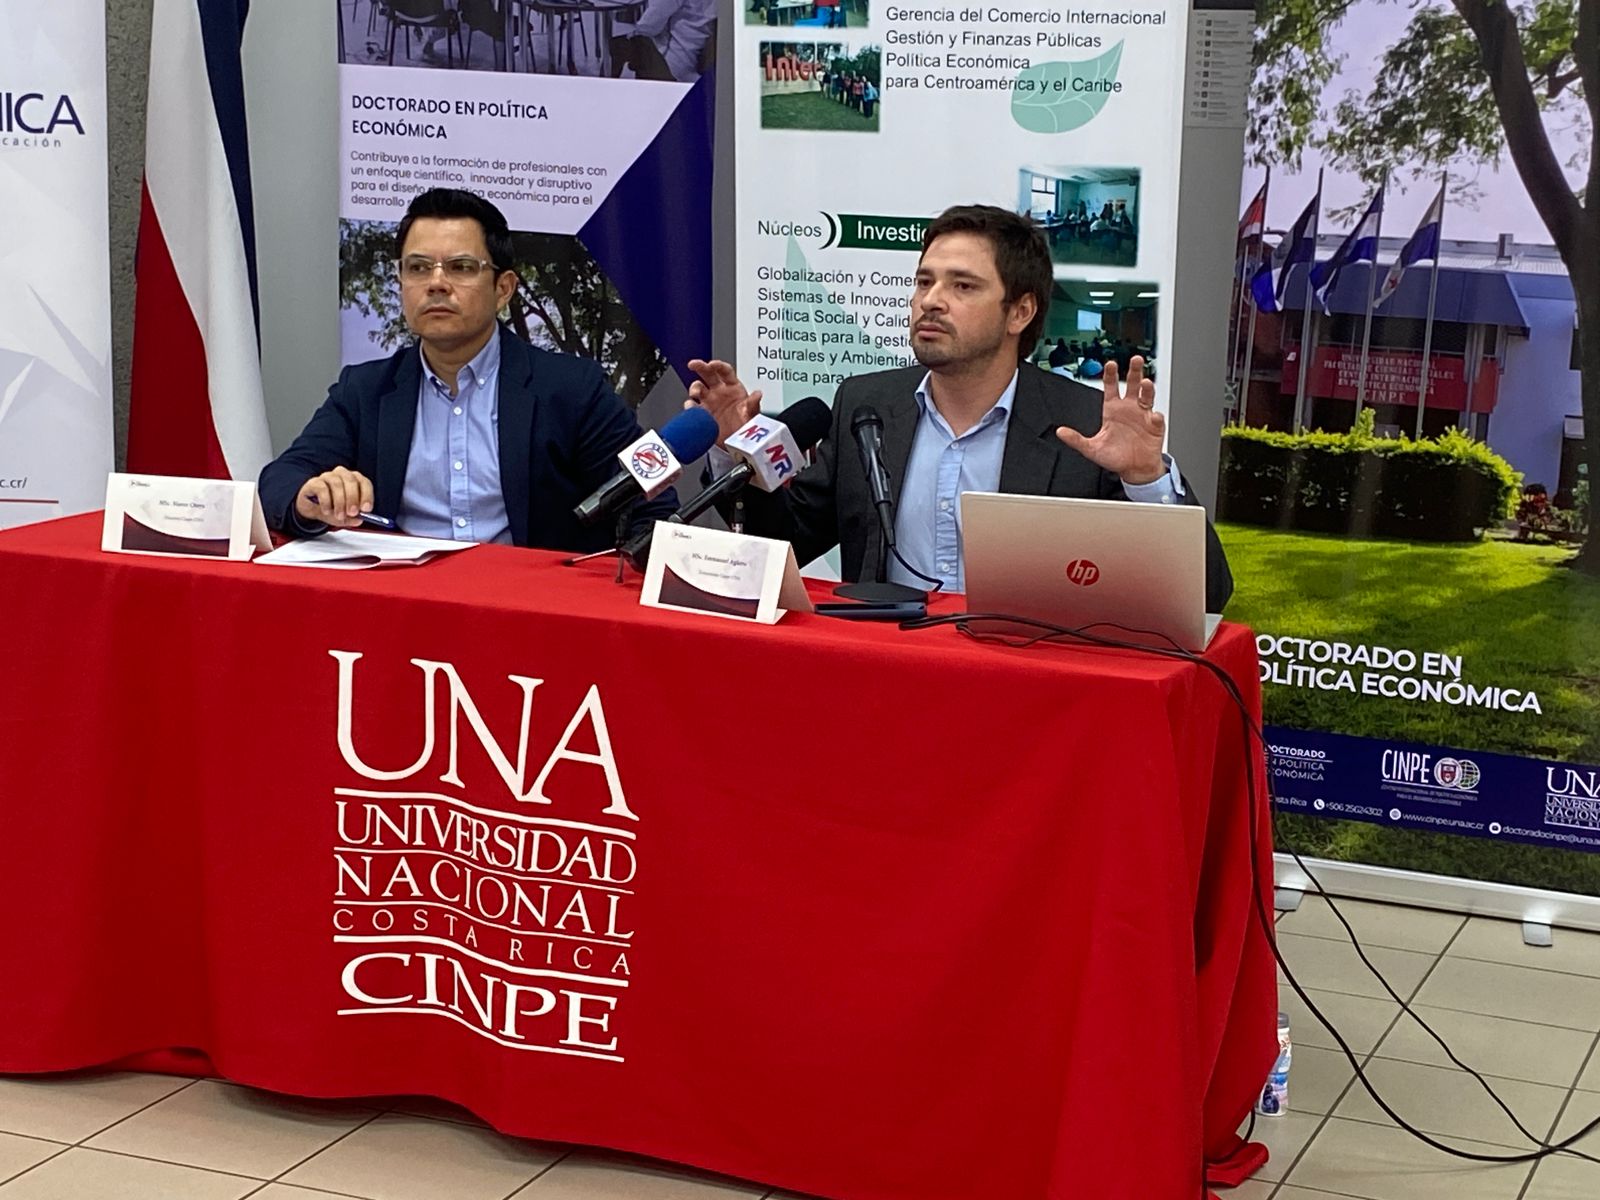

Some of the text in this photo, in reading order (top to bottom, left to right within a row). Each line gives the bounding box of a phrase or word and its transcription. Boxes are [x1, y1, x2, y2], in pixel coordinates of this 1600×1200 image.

[886, 7, 1166, 25] Gerencia del Comercio Internacional
[886, 30, 1101, 49] Gestión y Finanzas Públicas
[886, 52, 1030, 70] Política Económica
[885, 74, 1122, 95] para Centroamérica y el Caribe
[352, 95, 549, 120] DOCTORADO EN POLÍTICA
[352, 119, 448, 139] ECONÓMICA
[350, 150, 607, 177] Contribuye a la formación de profesionales con
[350, 167, 592, 192] un enfoque científico, innovador y disruptivo
[351, 180, 376, 192] para
[379, 182, 389, 191] el
[391, 183, 425, 195] diseño
[488, 188, 550, 203] económica
[552, 192, 580, 206] para
[582, 193, 593, 206] el
[351, 194, 405, 207] desarrollo
[758, 220, 822, 238] Núcleos
[757, 267, 853, 284] Globalización
[858, 274, 866, 287] y
[758, 289, 823, 304] Sistemas
[827, 291, 845, 305] de
[758, 308, 910, 328] Política Social y Calid
[758, 326, 817, 342] Políticas
[821, 333, 854, 348] para
[859, 330, 870, 345] la
[758, 346, 825, 363] Naturales
[829, 353, 838, 366] y
[757, 367, 808, 383] Política
[813, 372, 845, 387] para
[1071, 560, 1097, 587] hp
[1422, 653, 1462, 677] EN
[1362, 672, 1542, 715] ECONÓMICA
[328, 649, 640, 822] UNA
[1264, 745, 1326, 759] OCTORADO
[1265, 767, 1324, 781] ONÓMICA
[1279, 759, 1325, 771] POLÍTICA
[1381, 749, 1431, 784] CINPE
[1545, 804, 1600, 821] NACION
[335, 800, 637, 884] UNIVERSIDAD
[334, 853, 634, 938] NACIONAL
[333, 908, 631, 975] COSTA RICA
[341, 951, 619, 1051] CINPE
